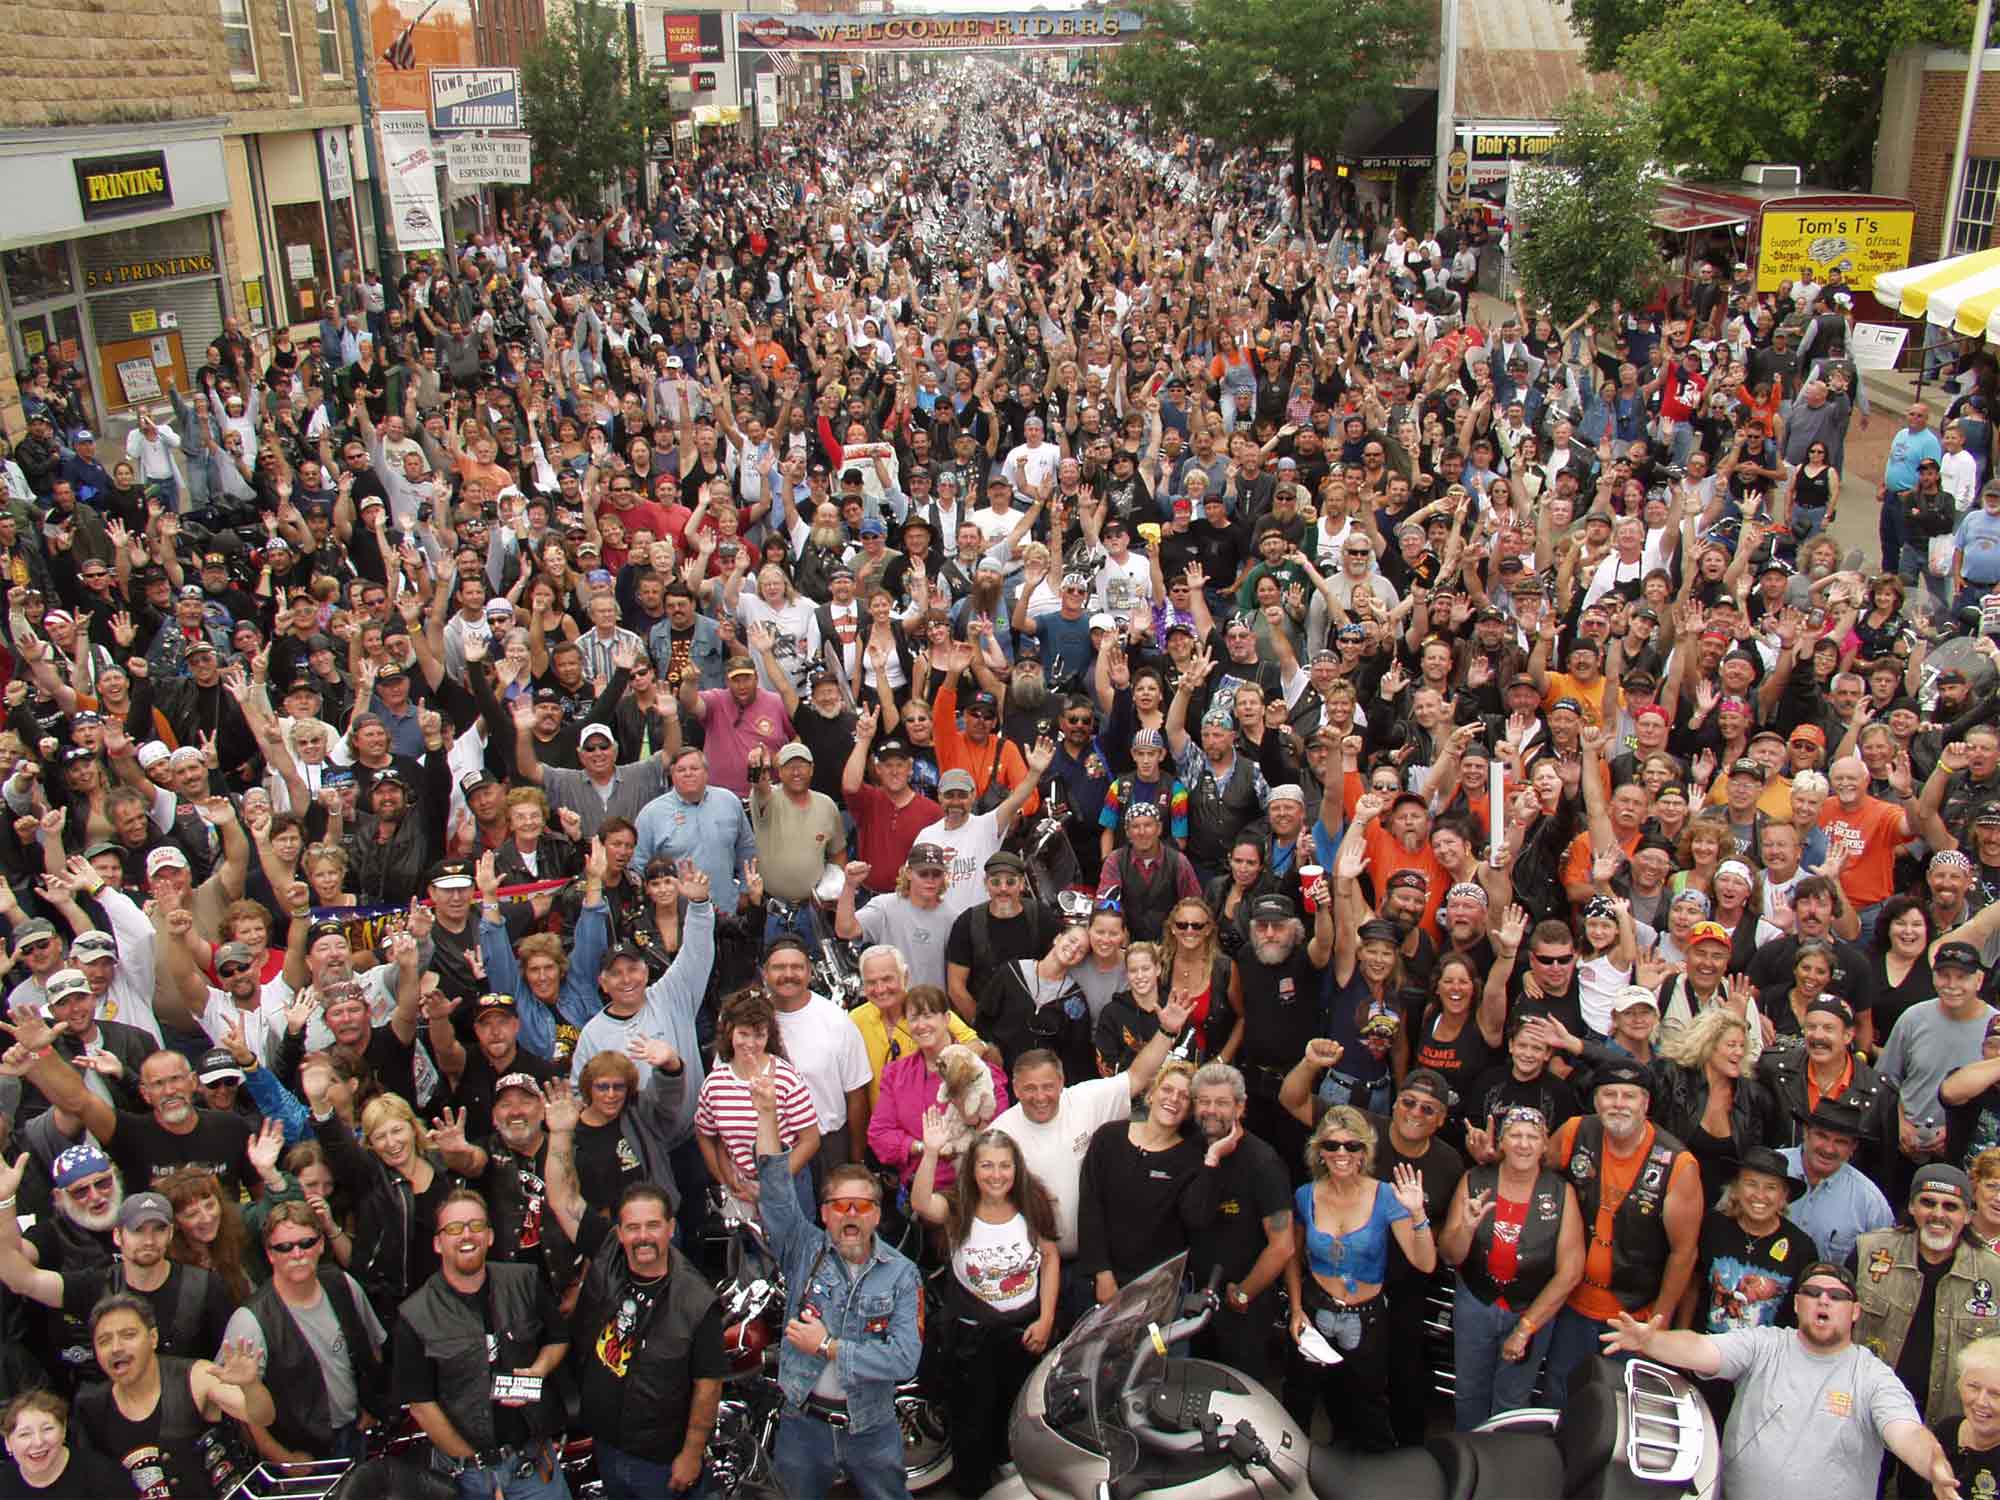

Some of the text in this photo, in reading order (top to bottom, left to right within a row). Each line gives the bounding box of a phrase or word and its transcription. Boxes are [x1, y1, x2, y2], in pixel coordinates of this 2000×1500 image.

[816, 16, 1121, 42] WELCOME RIDERS
[451, 105, 513, 125] PLUMBING
[1476, 135, 1516, 154] Bob's
[85, 167, 164, 202] PRINTING
[1799, 217, 1878, 234] Tom's T's
[119, 256, 212, 281] PRINTING
